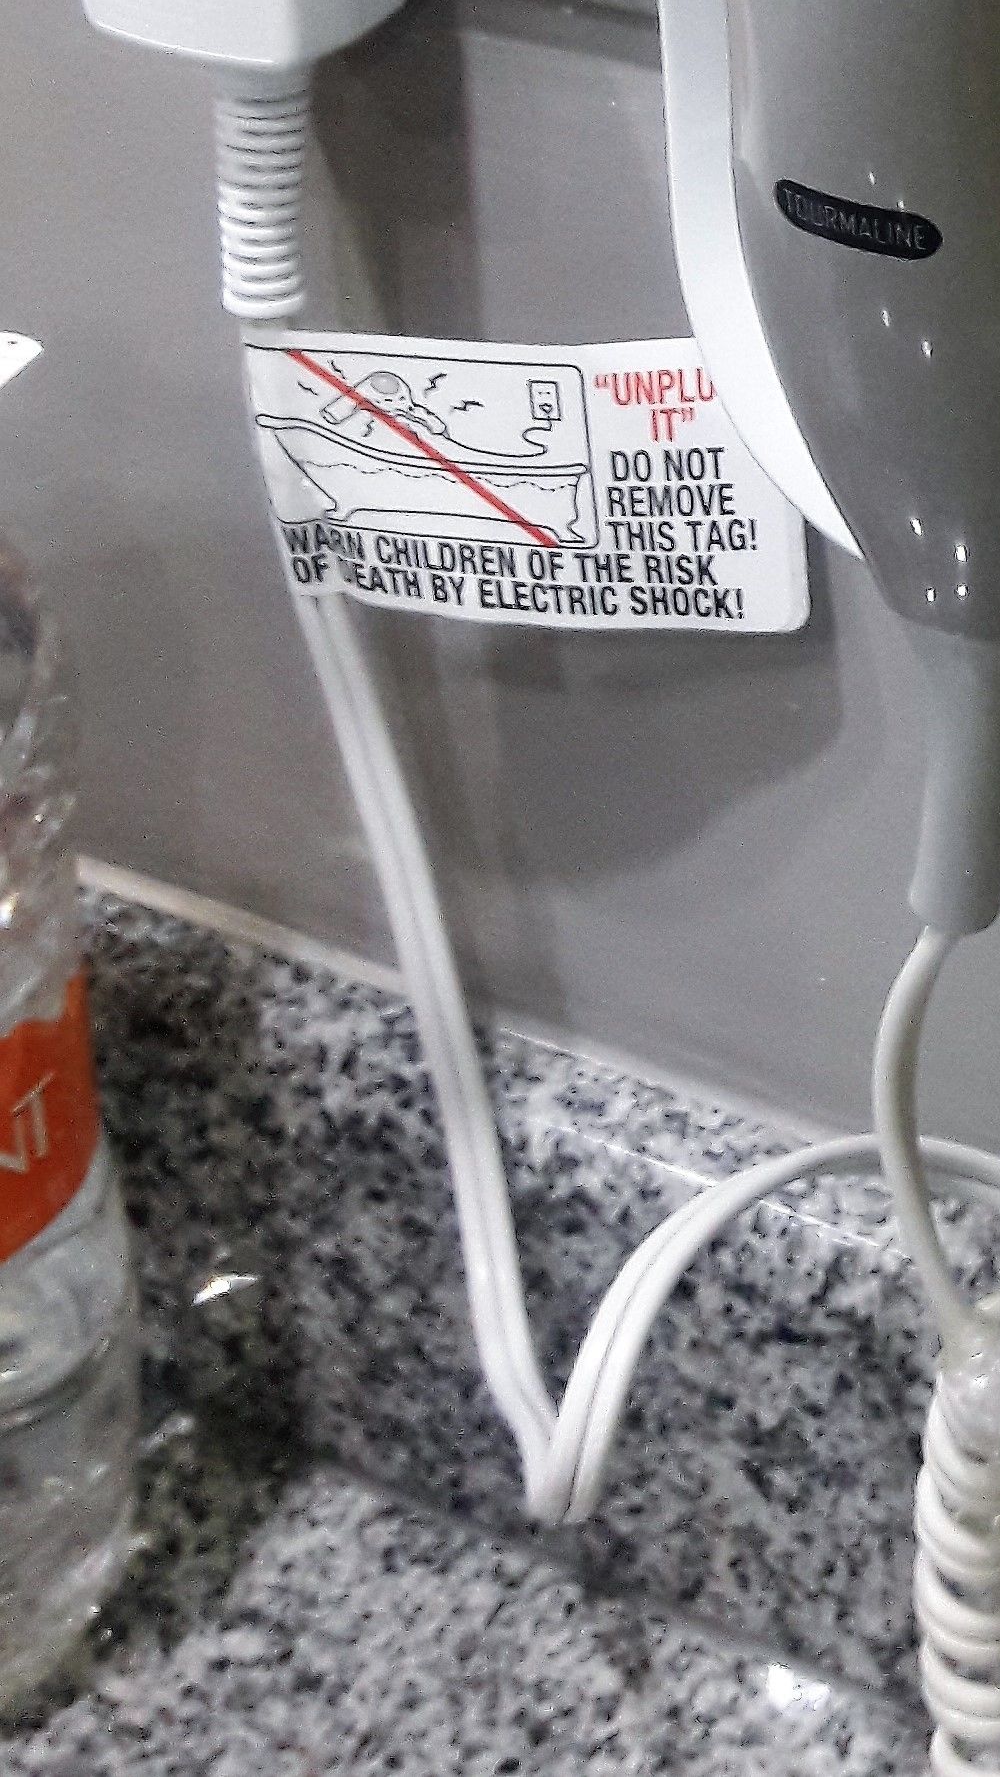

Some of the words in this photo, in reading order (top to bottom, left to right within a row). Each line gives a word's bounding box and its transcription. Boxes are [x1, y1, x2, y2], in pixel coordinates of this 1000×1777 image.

[783, 187, 928, 250] TOURMALINE
[610, 449, 651, 482] DO
[663, 447, 725, 482] NOT
[606, 483, 736, 518] REMOVE
[605, 520, 676, 553] THIS
[684, 518, 758, 552] TAG!
[376, 535, 518, 579] CHILDREN
[528, 548, 564, 581] OF
[573, 553, 634, 583] THE
[646, 554, 718, 586] RISK
[292, 553, 330, 583] OF
[431, 572, 465, 606] BY
[478, 579, 618, 616] ELECTRIC
[630, 586, 745, 620] SHOCK!
